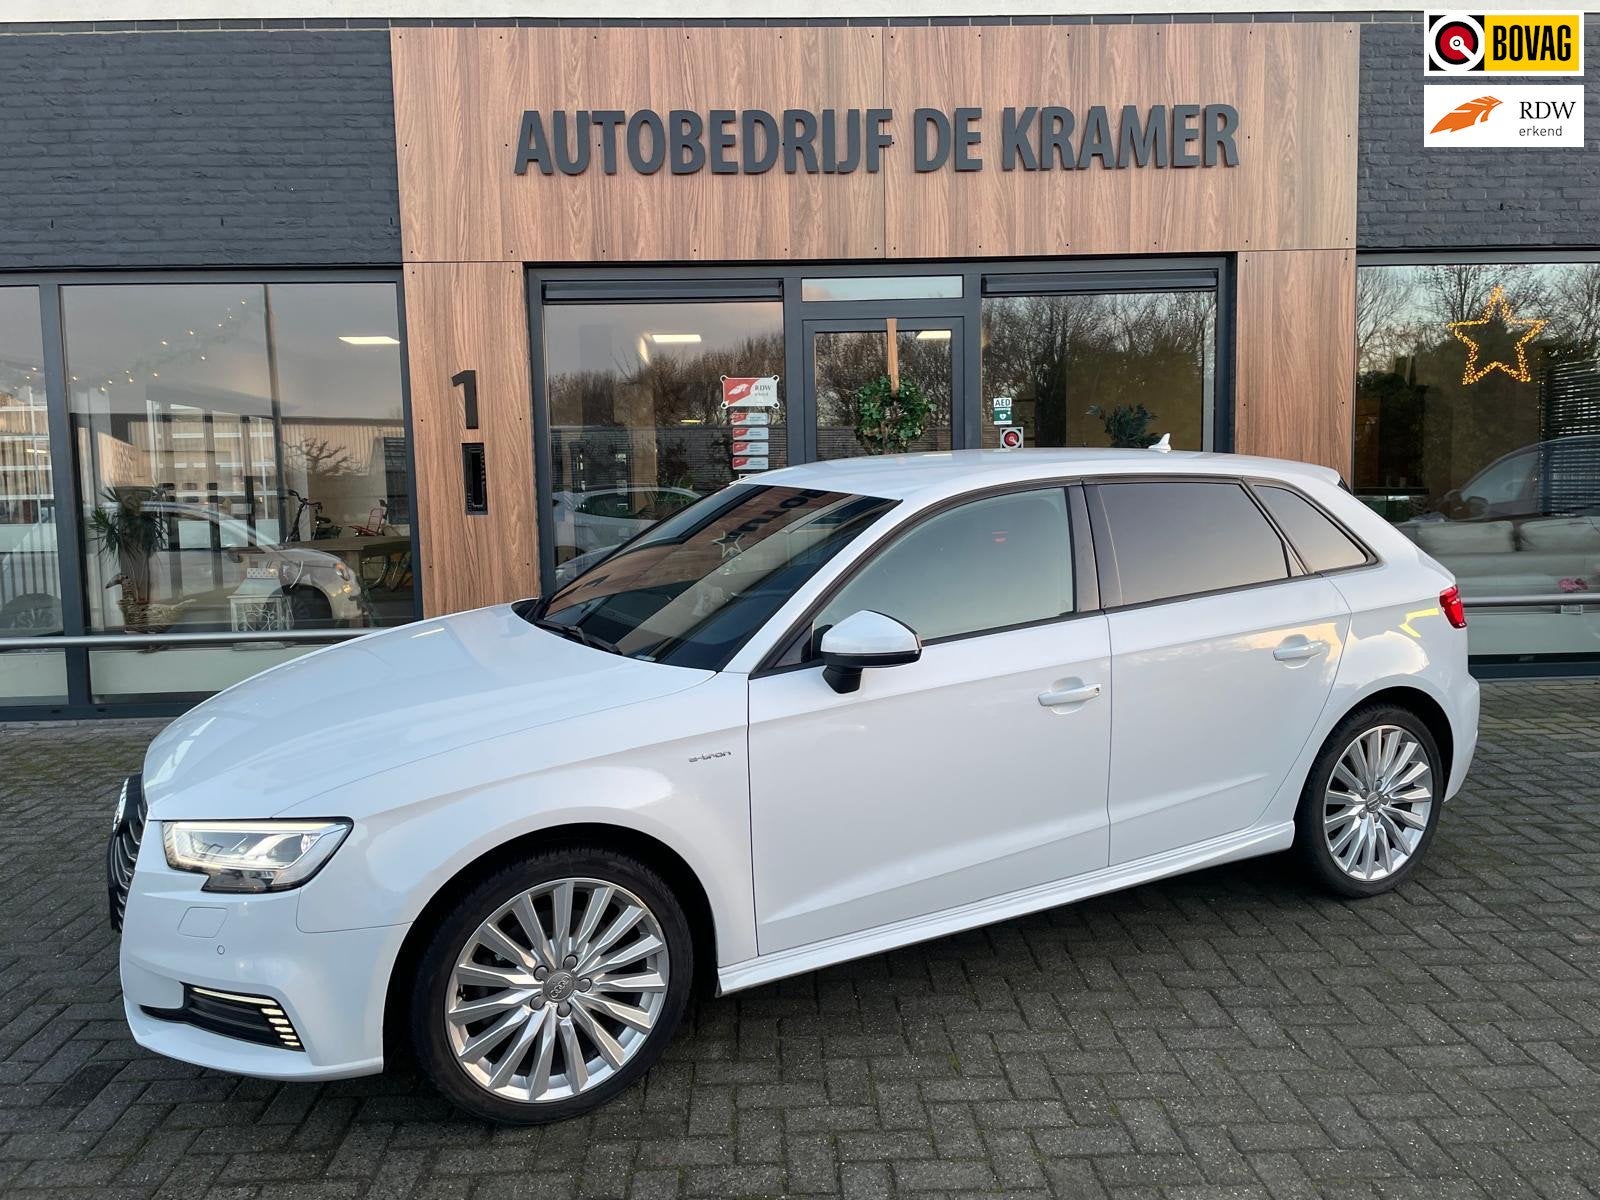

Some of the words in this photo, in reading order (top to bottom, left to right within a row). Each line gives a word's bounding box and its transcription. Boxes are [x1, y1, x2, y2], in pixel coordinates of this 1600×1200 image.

[514, 109, 893, 175] AUTOBEDRIJF
[914, 107, 984, 174] DE
[1002, 104, 1241, 172] KRAMER
[451, 370, 479, 430] 1
[994, 399, 1011, 407] AED
